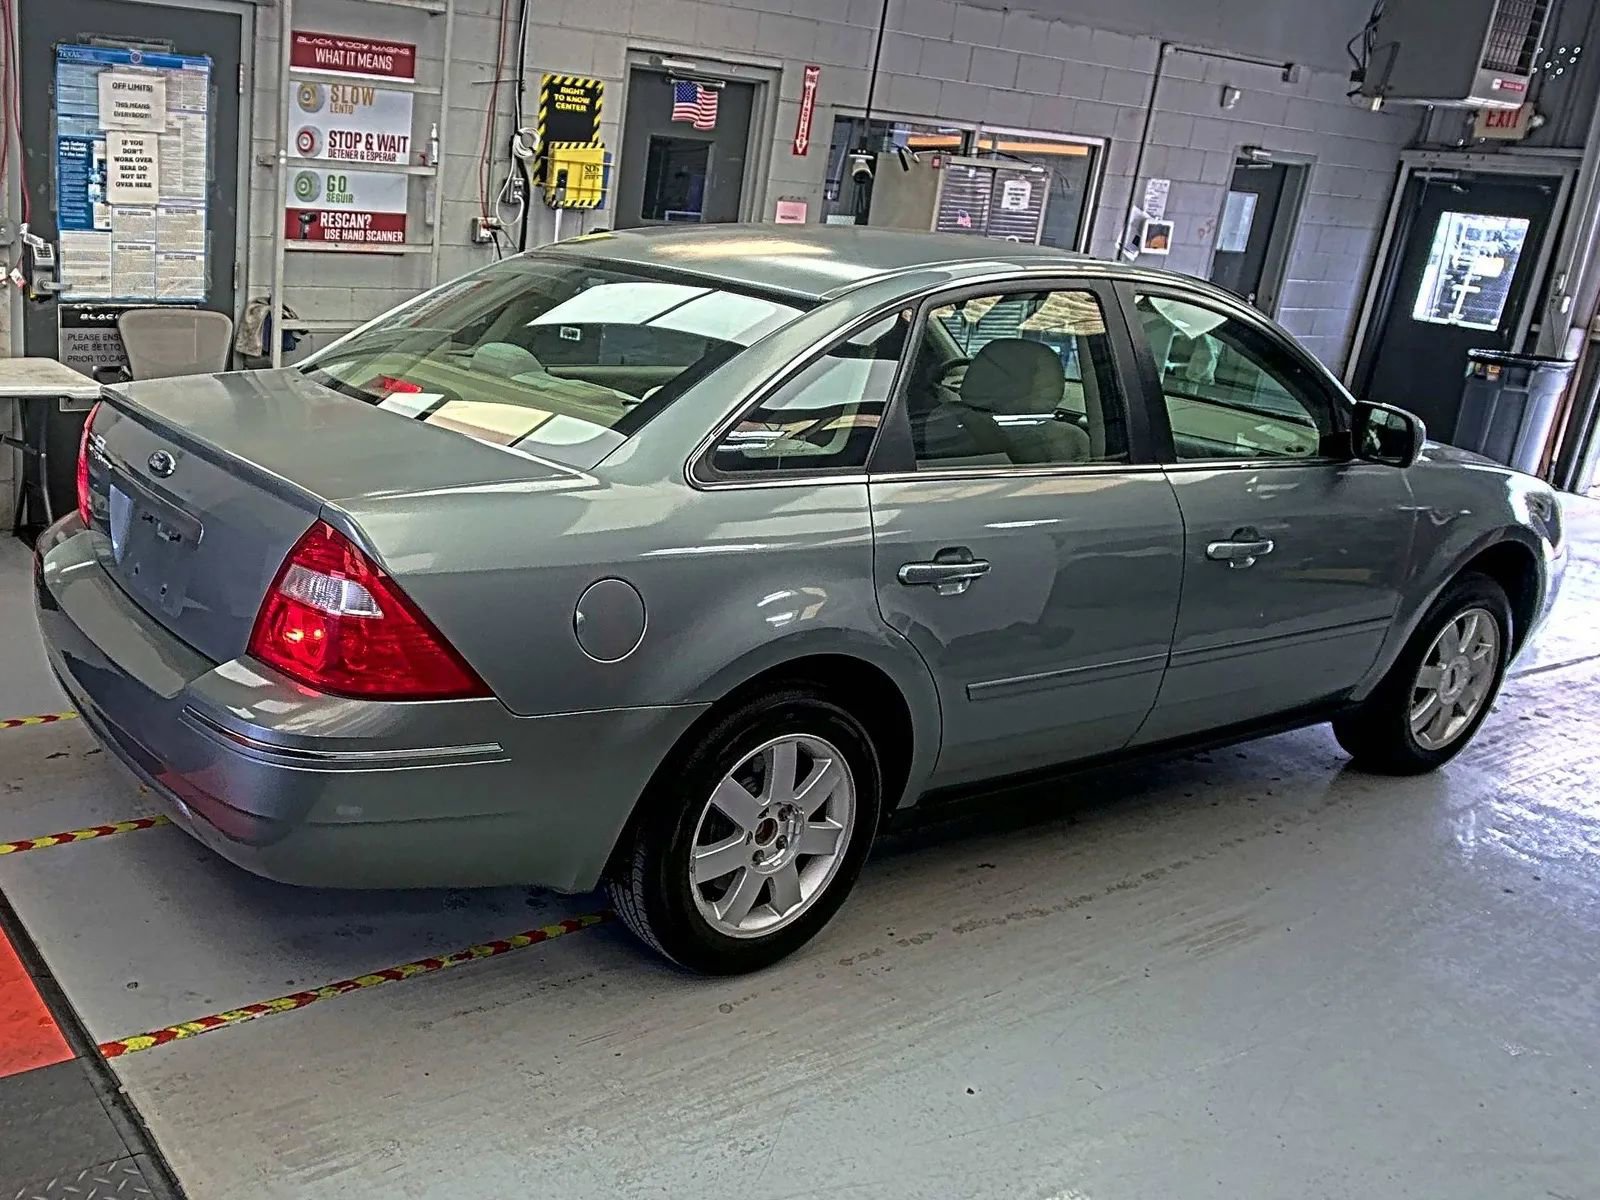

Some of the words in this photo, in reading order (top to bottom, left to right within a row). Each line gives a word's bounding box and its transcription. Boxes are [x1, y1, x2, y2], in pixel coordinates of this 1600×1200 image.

[315, 48, 344, 65] WHAT
[346, 51, 356, 66] IT
[357, 53, 393, 70] MEANS
[112, 81, 127, 90] OFF
[560, 86, 585, 95] RIGHT
[330, 84, 375, 106] SLOW
[553, 93, 565, 101] TO
[566, 95, 591, 104] KNOW
[329, 103, 354, 114] LENTO
[555, 101, 587, 112] CENTER
[1485, 108, 1521, 128] EXIT
[328, 130, 362, 149] STOP
[364, 133, 374, 151] &
[377, 133, 409, 153] WAIT
[328, 148, 359, 160] DETENER
[359, 150, 365, 161] &
[366, 150, 397, 162] ESPERAR
[327, 174, 347, 193] GO
[326, 193, 354, 204] SEGUIR
[319, 212, 372, 229] RESCAN?
[324, 228, 341, 240] USE
[342, 229, 365, 241] HAND
[366, 230, 403, 243] SCANNER
[67, 333, 101, 342] PLEASE
[102, 333, 121, 342] ENS
[71, 343, 89, 352] ARE
[91, 343, 107, 352] SET
[110, 343, 121, 352] TO
[67, 354, 94, 363] PRIOR
[96, 354, 108, 363] TO
